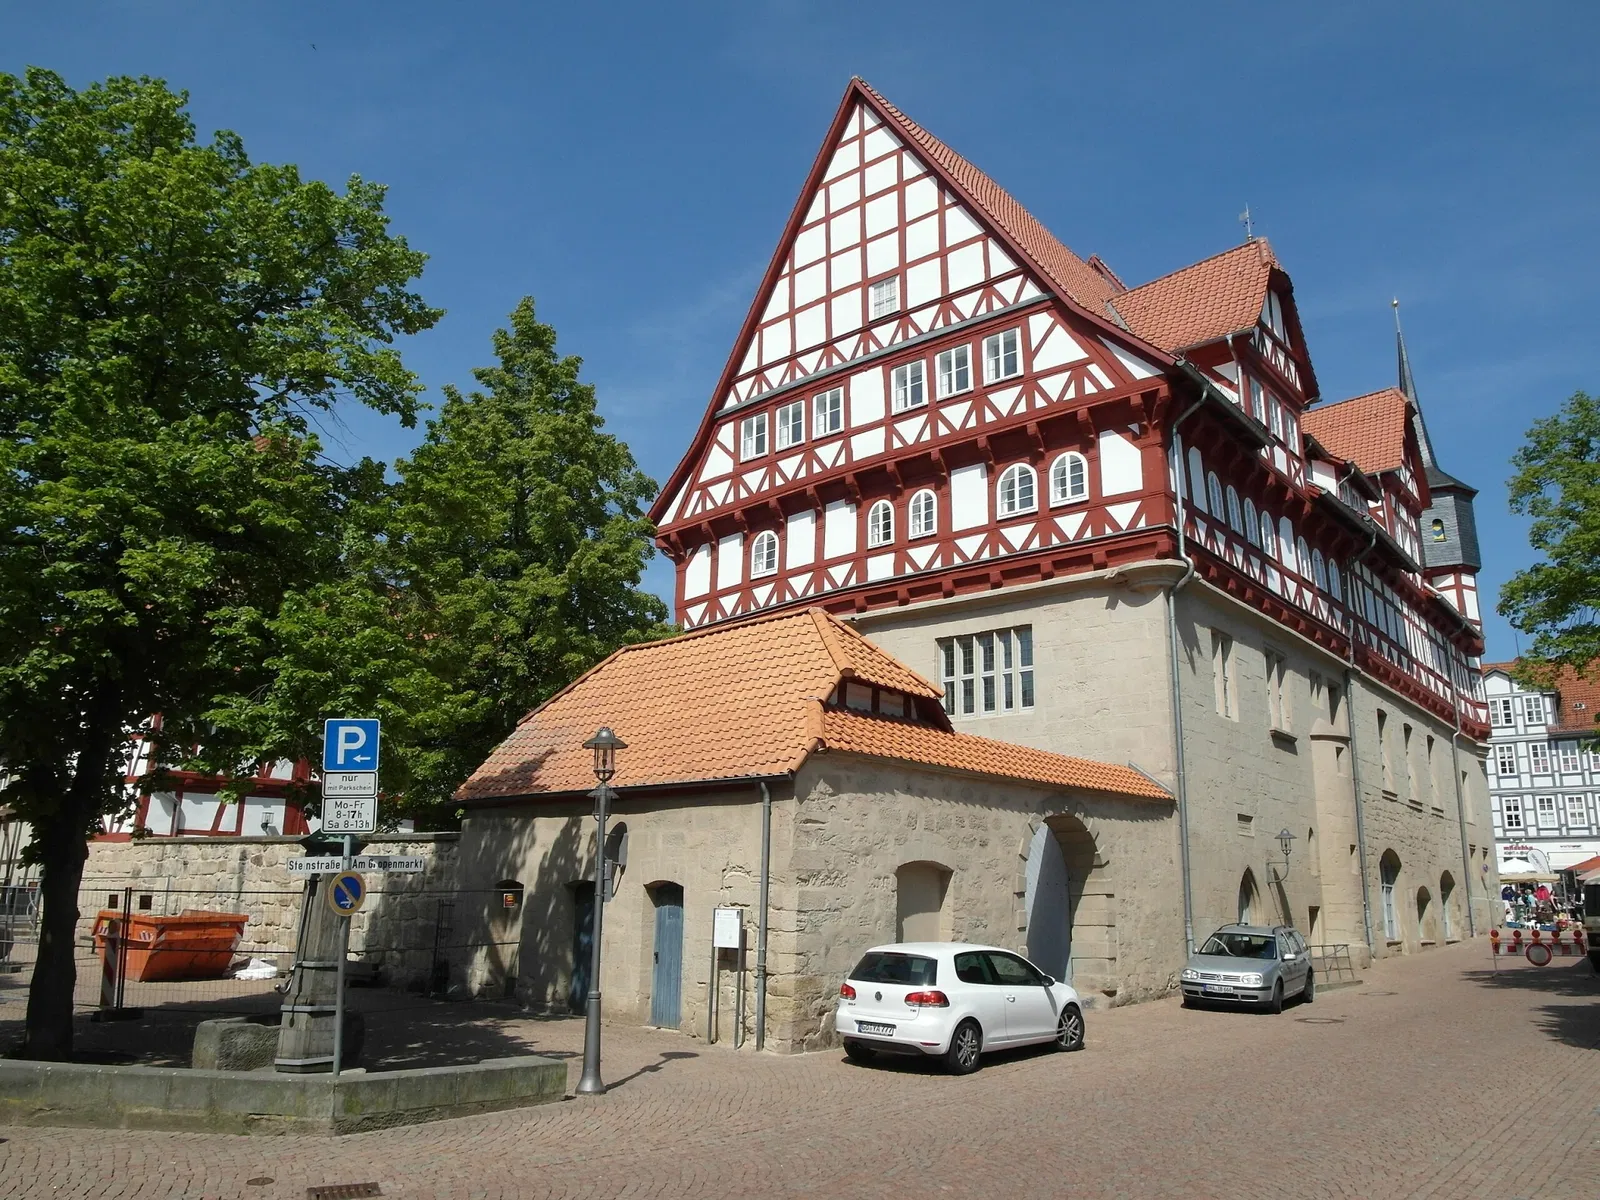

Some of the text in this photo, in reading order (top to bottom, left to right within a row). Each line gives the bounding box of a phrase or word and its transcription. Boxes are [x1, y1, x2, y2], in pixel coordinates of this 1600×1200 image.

[337, 726, 366, 765] P
[334, 800, 365, 810] Mo-Fr
[327, 820, 370, 829] Sa 8-13h
[288, 859, 341, 871] Stenstraße
[352, 860, 366, 869] Am
